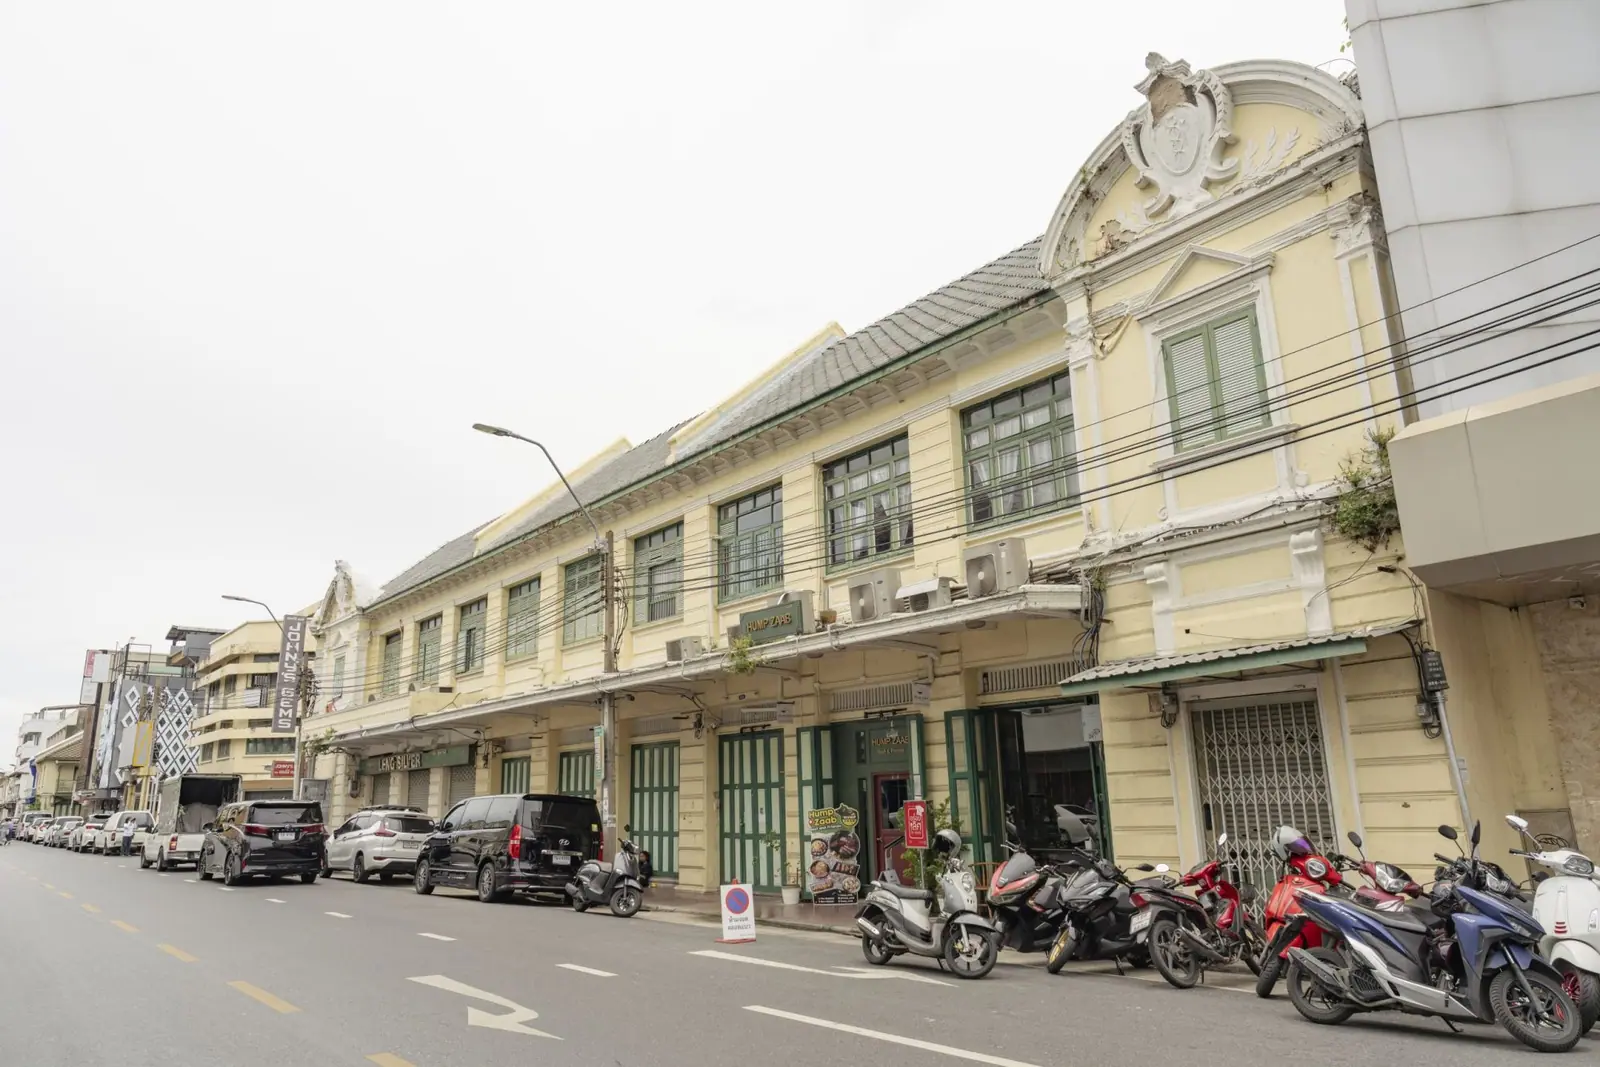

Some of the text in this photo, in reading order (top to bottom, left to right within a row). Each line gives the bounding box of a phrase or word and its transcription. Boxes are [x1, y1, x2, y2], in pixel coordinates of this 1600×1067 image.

[747, 613, 792, 632] HUMP ZAAB
[278, 687, 295, 728] GEMS
[872, 737, 892, 746] HUMP
[809, 809, 834, 818] Hump
[814, 817, 837, 825] Zaab
